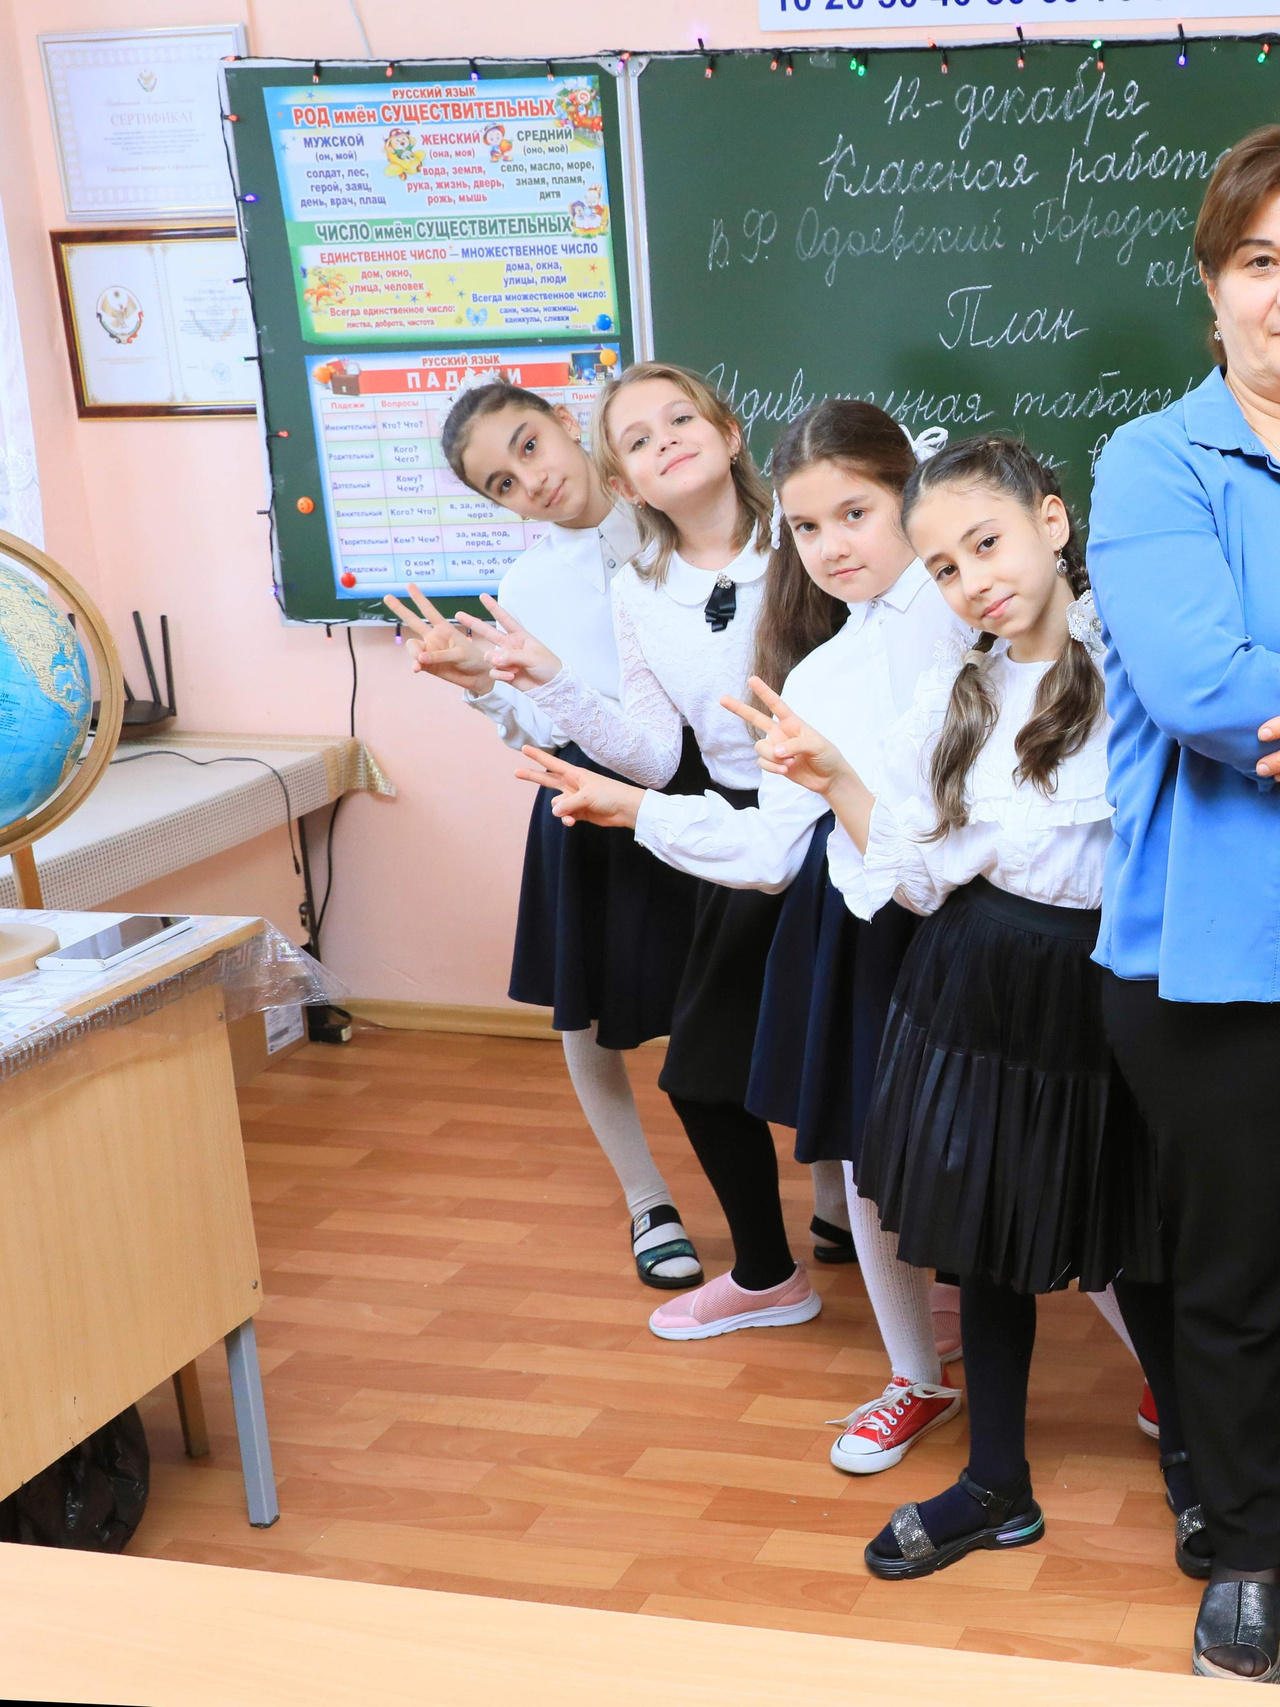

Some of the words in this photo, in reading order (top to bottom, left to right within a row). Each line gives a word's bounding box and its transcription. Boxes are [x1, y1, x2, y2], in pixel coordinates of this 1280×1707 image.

[392, 84, 442, 99] РУССКИЙ
[446, 87, 476, 97] ЯЗЫК
[955, 57, 1150, 150] декабря
[293, 107, 330, 127] РОД
[334, 107, 376, 123] имён
[381, 99, 557, 124] СУЩЕСТВИТЕЛЬНЫХ
[304, 134, 364, 148] МУЖСКОЙ
[421, 131, 480, 145] ЖЕНСКИЙ
[517, 127, 572, 142] СРЕДНИЙ
[316, 152, 333, 162] (он,
[336, 150, 357, 161] мой)
[430, 150, 452, 159] (она,
[455, 149, 475, 158] моя)
[523, 146, 546, 156] (оно,
[423, 166, 449, 176] вода,
[452, 165, 486, 175] земля,
[501, 163, 527, 173] село,
[530, 162, 563, 172] масло,
[567, 161, 594, 170] море,
[820, 134, 1039, 200] Классная
[306, 169, 344, 179] солдат,
[348, 169, 369, 178] лес,
[516, 175, 549, 186] знамя,
[552, 175, 585, 185] пламя,
[311, 182, 342, 194] герой,
[407, 181, 433, 192] рука,
[436, 179, 470, 190] жизнь,
[473, 179, 505, 190] дверь,
[301, 198, 328, 208] день,
[330, 198, 356, 207] врач,
[360, 195, 386, 205] плащ
[428, 195, 455, 205] рожь,
[459, 194, 487, 203] мышь
[539, 190, 561, 200] дитя
[317, 224, 370, 241] ЧИСЛО
[374, 223, 412, 239] имён
[416, 216, 572, 239] СУЩЕСТВИТЕЛЬНЫХ
[796, 205, 1006, 287] Одоевский
[320, 250, 407, 265] ЕДИНСТВЕННОЕ
[410, 249, 446, 260] ЧИСЛО
[462, 244, 556, 258] МНОЖЕСТВЕННОЕ
[561, 243, 598, 254] ЧИСЛО
[506, 262, 533, 272] дома,
[536, 261, 562, 271] окна,
[361, 270, 383, 280] дом,
[386, 269, 412, 278] окно,
[503, 276, 537, 287] улицы,
[540, 275, 567, 284] люди
[349, 284, 382, 295] улица,
[384, 282, 424, 292] человек
[938, 284, 1090, 350] План
[422, 354, 468, 367] РУССКИЙ
[471, 355, 500, 365] ЯЗЫК
